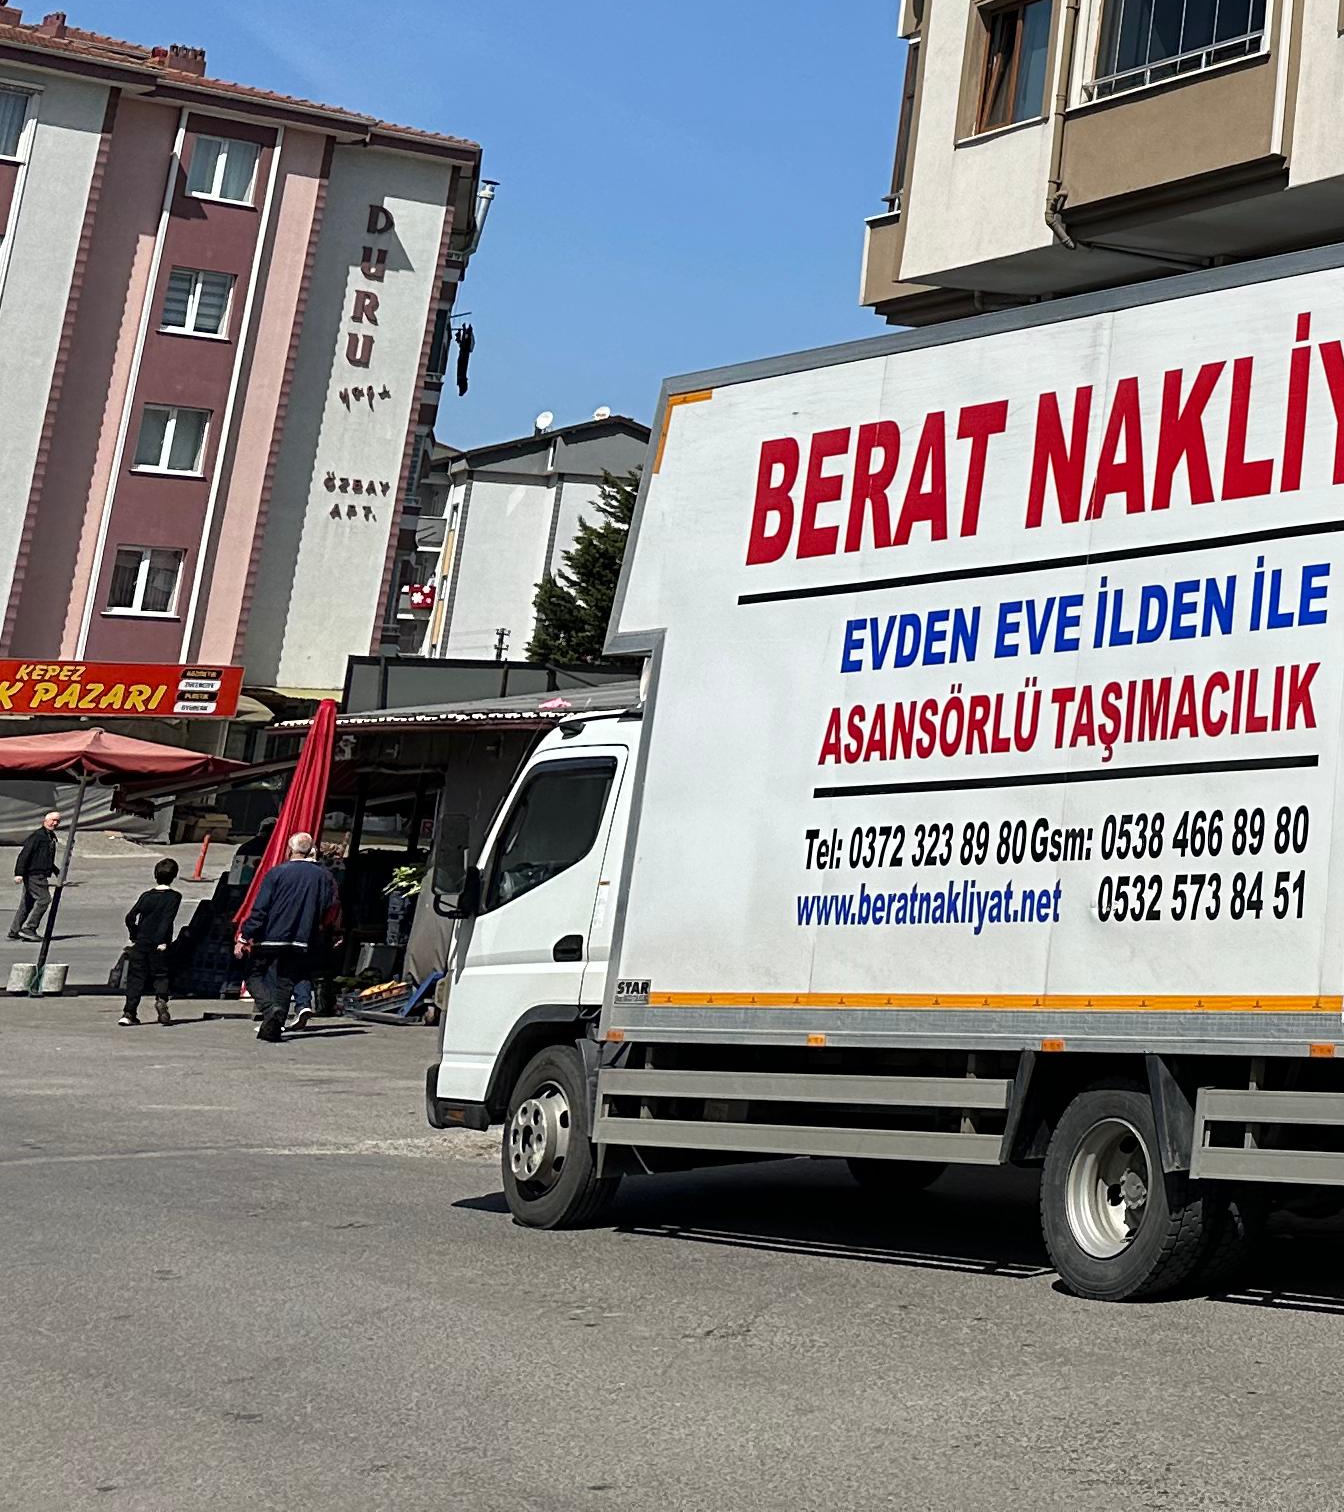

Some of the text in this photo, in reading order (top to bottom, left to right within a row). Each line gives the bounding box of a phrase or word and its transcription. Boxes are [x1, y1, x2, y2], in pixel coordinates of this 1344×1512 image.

[345, 204, 396, 369] DURU
[744, 399, 1011, 567] BERAT
[840, 555, 1332, 675] EVDEN EVE İLDEN İLE
[15, 665, 87, 681] KEPEZ
[29, 682, 168, 713] PAZARI
[818, 662, 1321, 766] ASANSÖRLÜ TAŞIMACILIK
[805, 805, 1310, 871] Tel: 0372 323 89 80 Gsm: 0538 466 89 80
[796, 869, 1306, 936] www.beratnakliyat.net 0532 573 84 51
[616, 981, 650, 995] STAR
